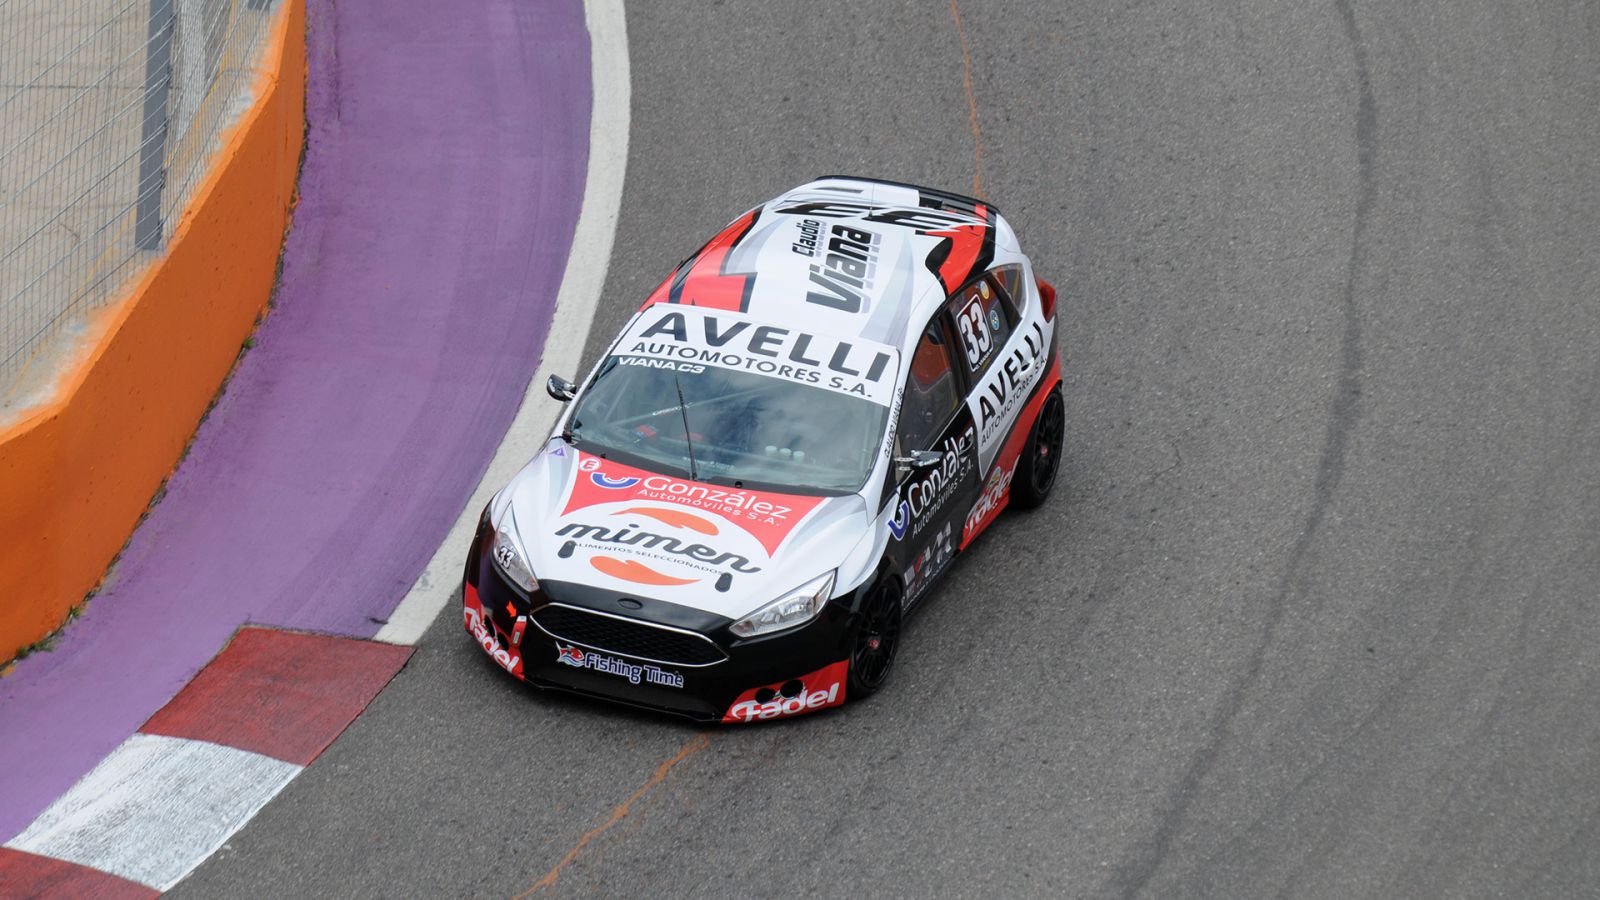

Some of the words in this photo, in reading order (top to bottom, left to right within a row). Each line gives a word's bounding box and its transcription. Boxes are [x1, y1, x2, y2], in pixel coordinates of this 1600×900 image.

[792, 219, 821, 257] Claudio
[805, 224, 872, 314] Viana
[639, 312, 891, 382] AVELLI
[959, 302, 991, 365] 33
[630, 341, 820, 383] AUTOMOTORES
[828, 376, 873, 398] S.A.
[976, 320, 1045, 430] AVELLI
[637, 489, 742, 517] Automóviles
[746, 512, 782, 527] S.A.
[643, 476, 793, 520] González
[497, 545, 515, 570] 33
[554, 523, 762, 574] mimen
[574, 542, 633, 554] LIMENTOS
[585, 653, 641, 684] Fishing
[643, 665, 684, 688] Time
[731, 682, 840, 723] Fadel
